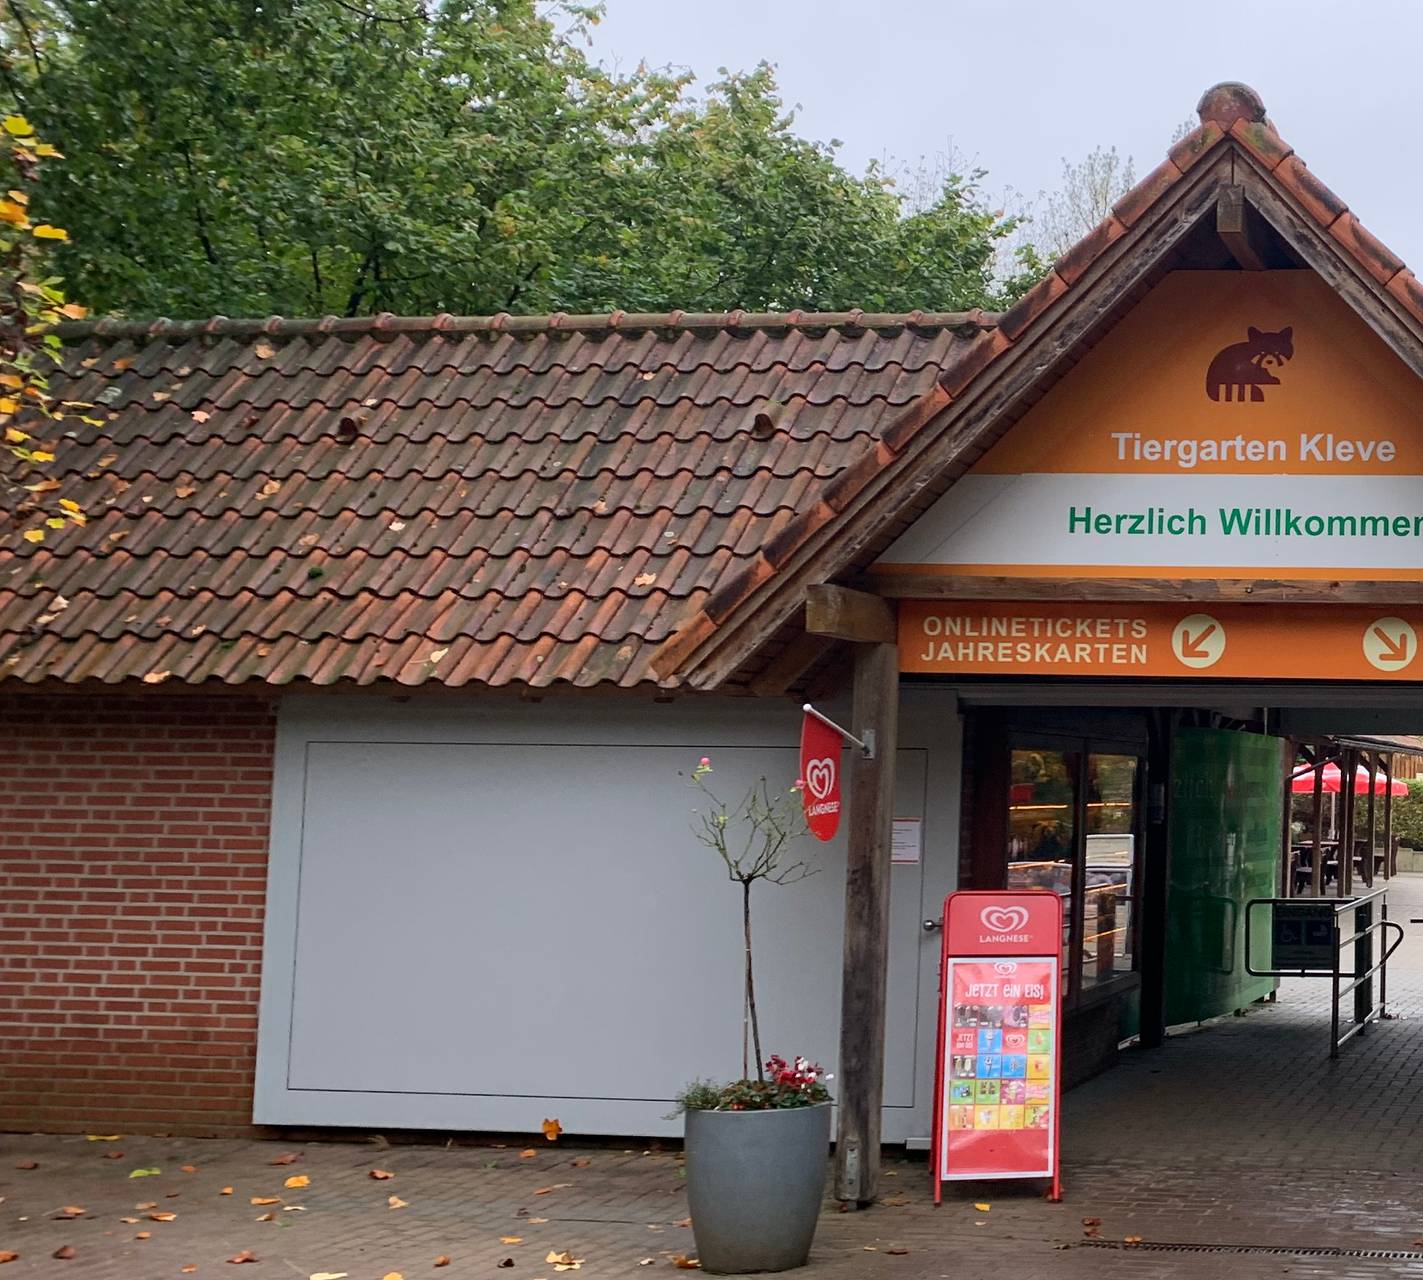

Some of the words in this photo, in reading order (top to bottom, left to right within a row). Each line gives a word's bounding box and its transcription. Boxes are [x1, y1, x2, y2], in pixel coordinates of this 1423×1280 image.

[1112, 433, 1287, 468] Tiergarten
[1300, 434, 1396, 462] Kleve
[1069, 507, 1207, 537] Herzlich
[923, 616, 1148, 639] ONLINETICKETS
[921, 642, 1147, 664] JAHRESKARTEN
[979, 935, 1032, 943] LANGNESE
